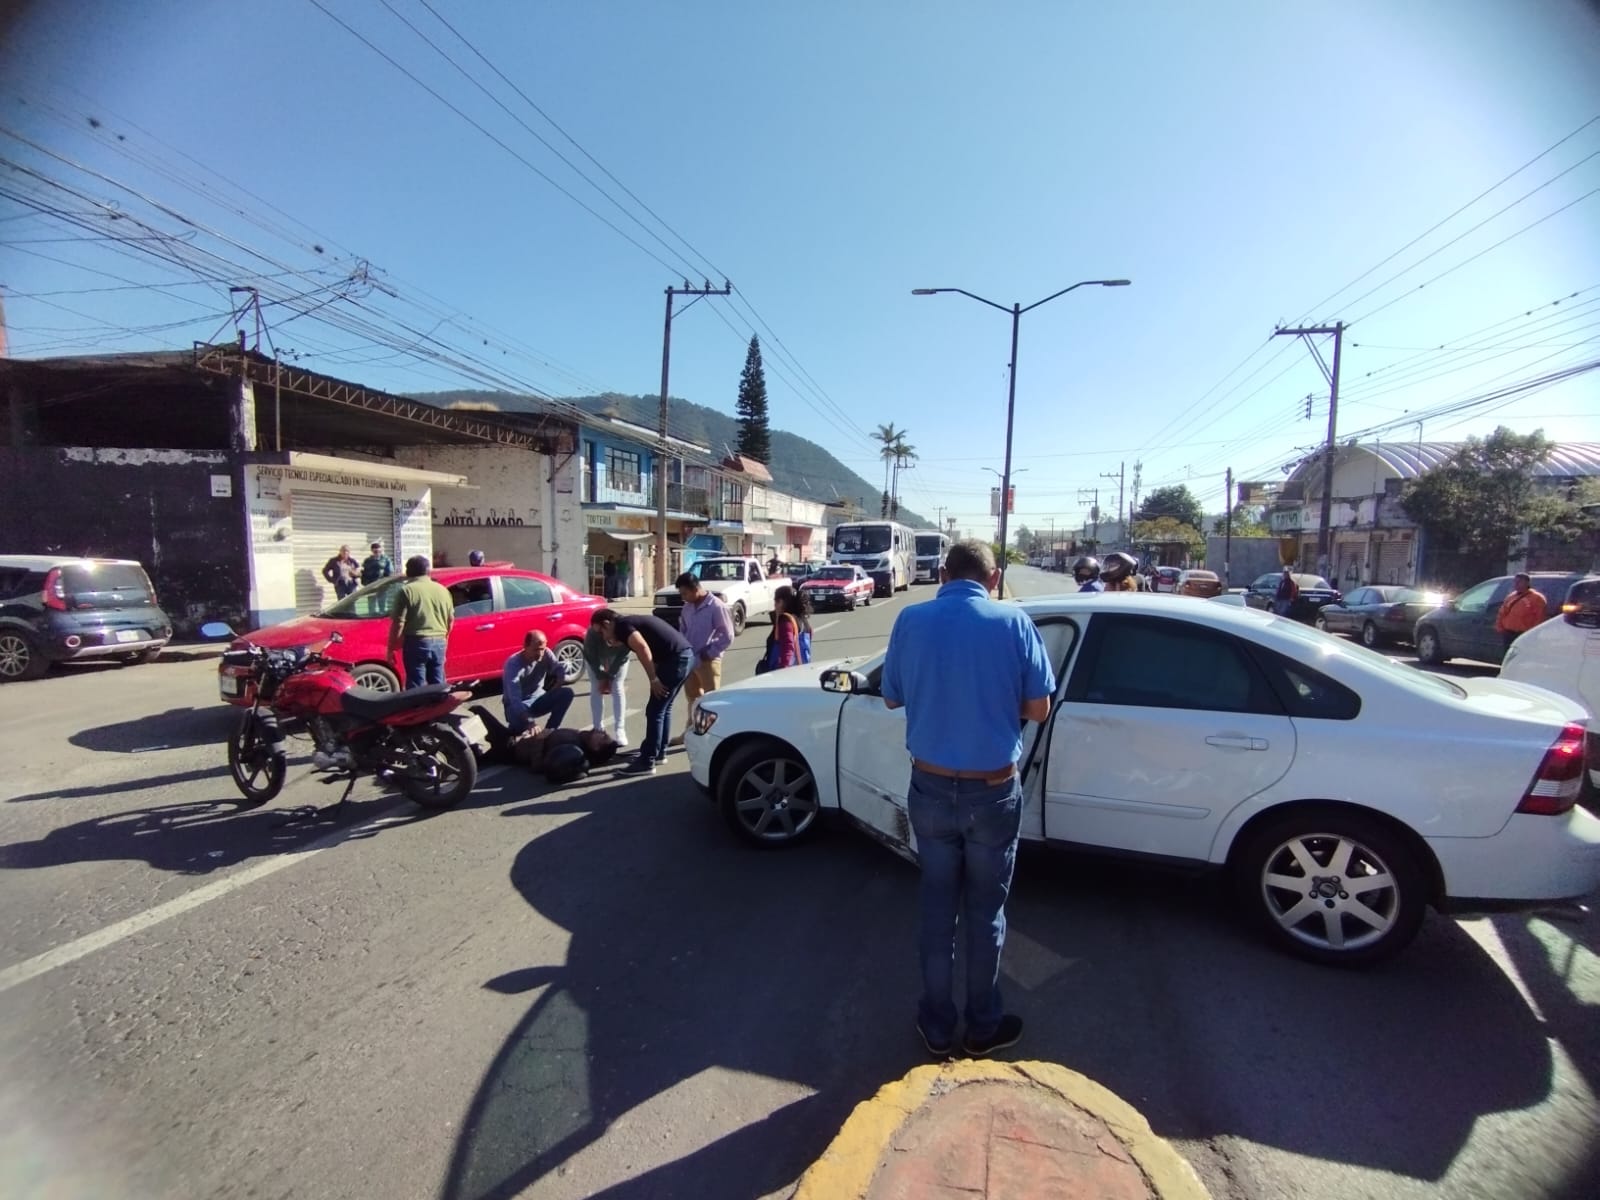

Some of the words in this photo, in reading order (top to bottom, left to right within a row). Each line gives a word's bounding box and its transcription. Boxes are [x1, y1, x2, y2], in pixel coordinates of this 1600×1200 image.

[256, 465, 283, 478] SERVICIO
[353, 476, 360, 487] EN
[443, 516, 474, 528] AUTO
